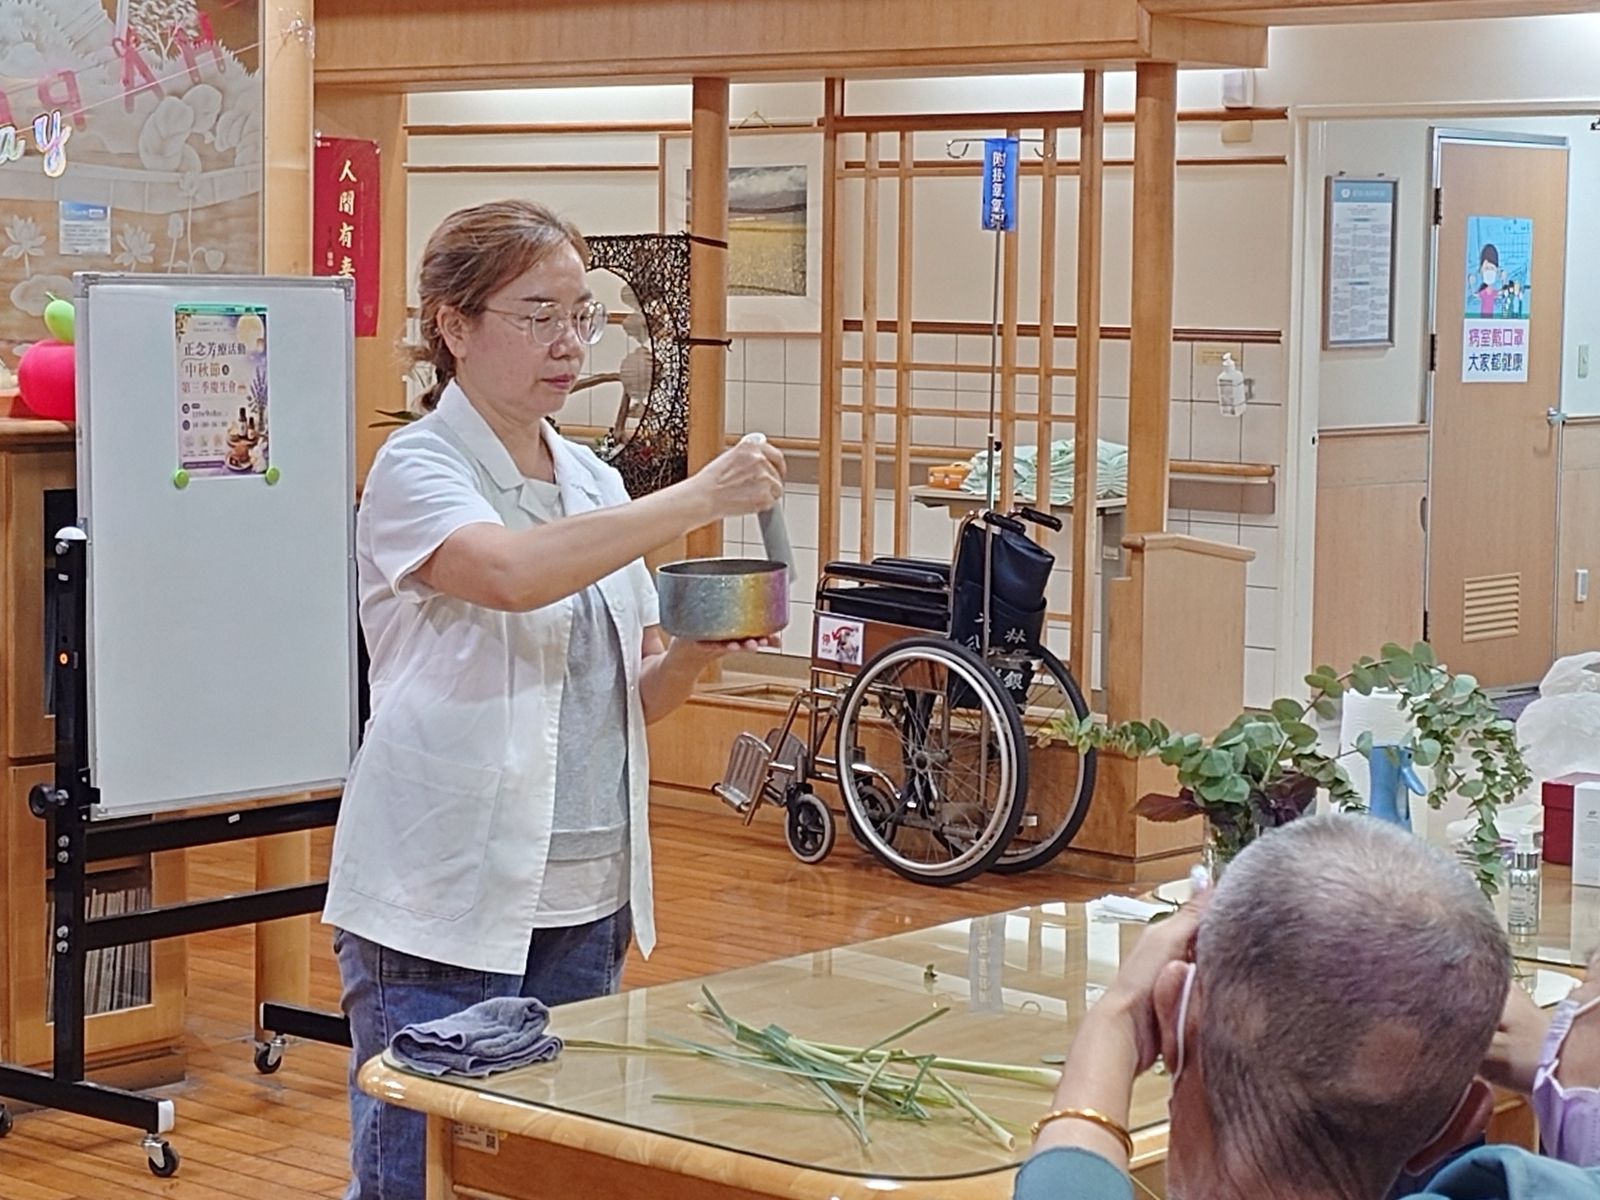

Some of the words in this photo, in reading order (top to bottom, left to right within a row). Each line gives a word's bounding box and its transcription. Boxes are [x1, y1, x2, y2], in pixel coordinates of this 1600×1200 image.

[1469, 328, 1524, 348] 病室戴口罩
[1468, 352, 1523, 372] 大家都健康
